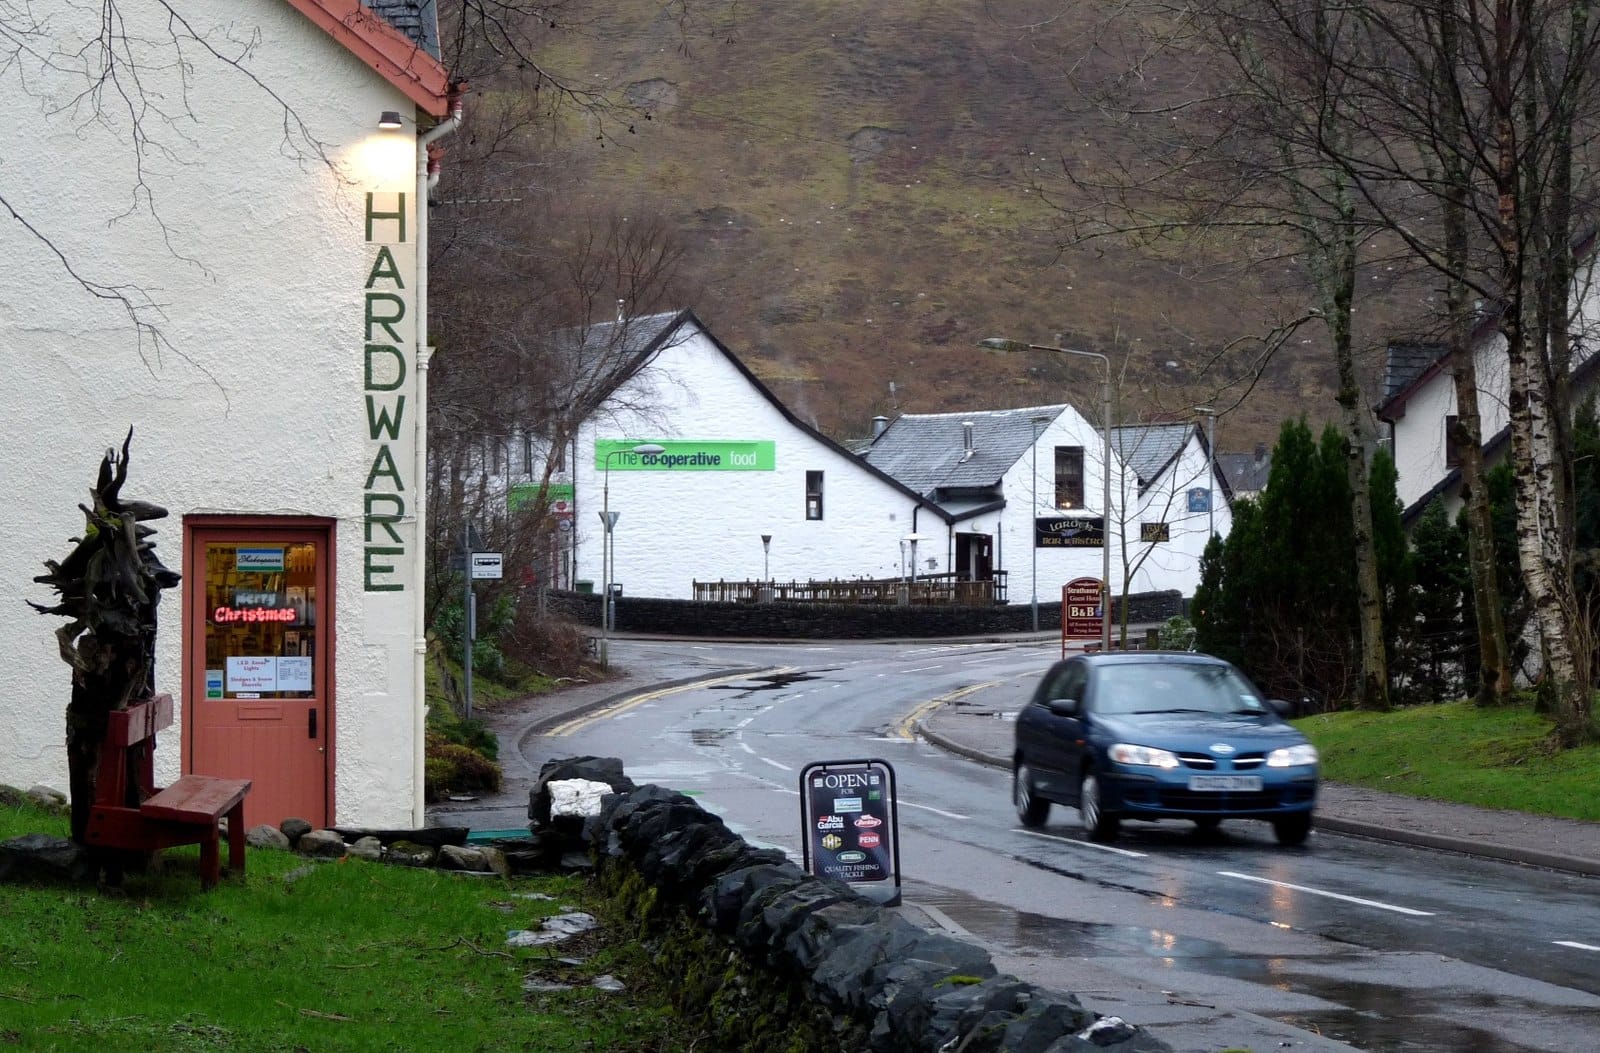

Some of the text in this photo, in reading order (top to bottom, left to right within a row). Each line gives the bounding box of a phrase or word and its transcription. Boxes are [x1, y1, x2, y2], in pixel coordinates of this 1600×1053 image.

[364, 192, 407, 592] HARDWARE
[617, 451, 757, 468] The co-operative food
[235, 593, 276, 606] Merry
[215, 607, 295, 622] Christmas
[825, 774, 868, 788] OPEN
[817, 822, 844, 830] Garcia
[859, 836, 879, 844] PENN
[824, 863, 880, 873] QUALITY FISHING
